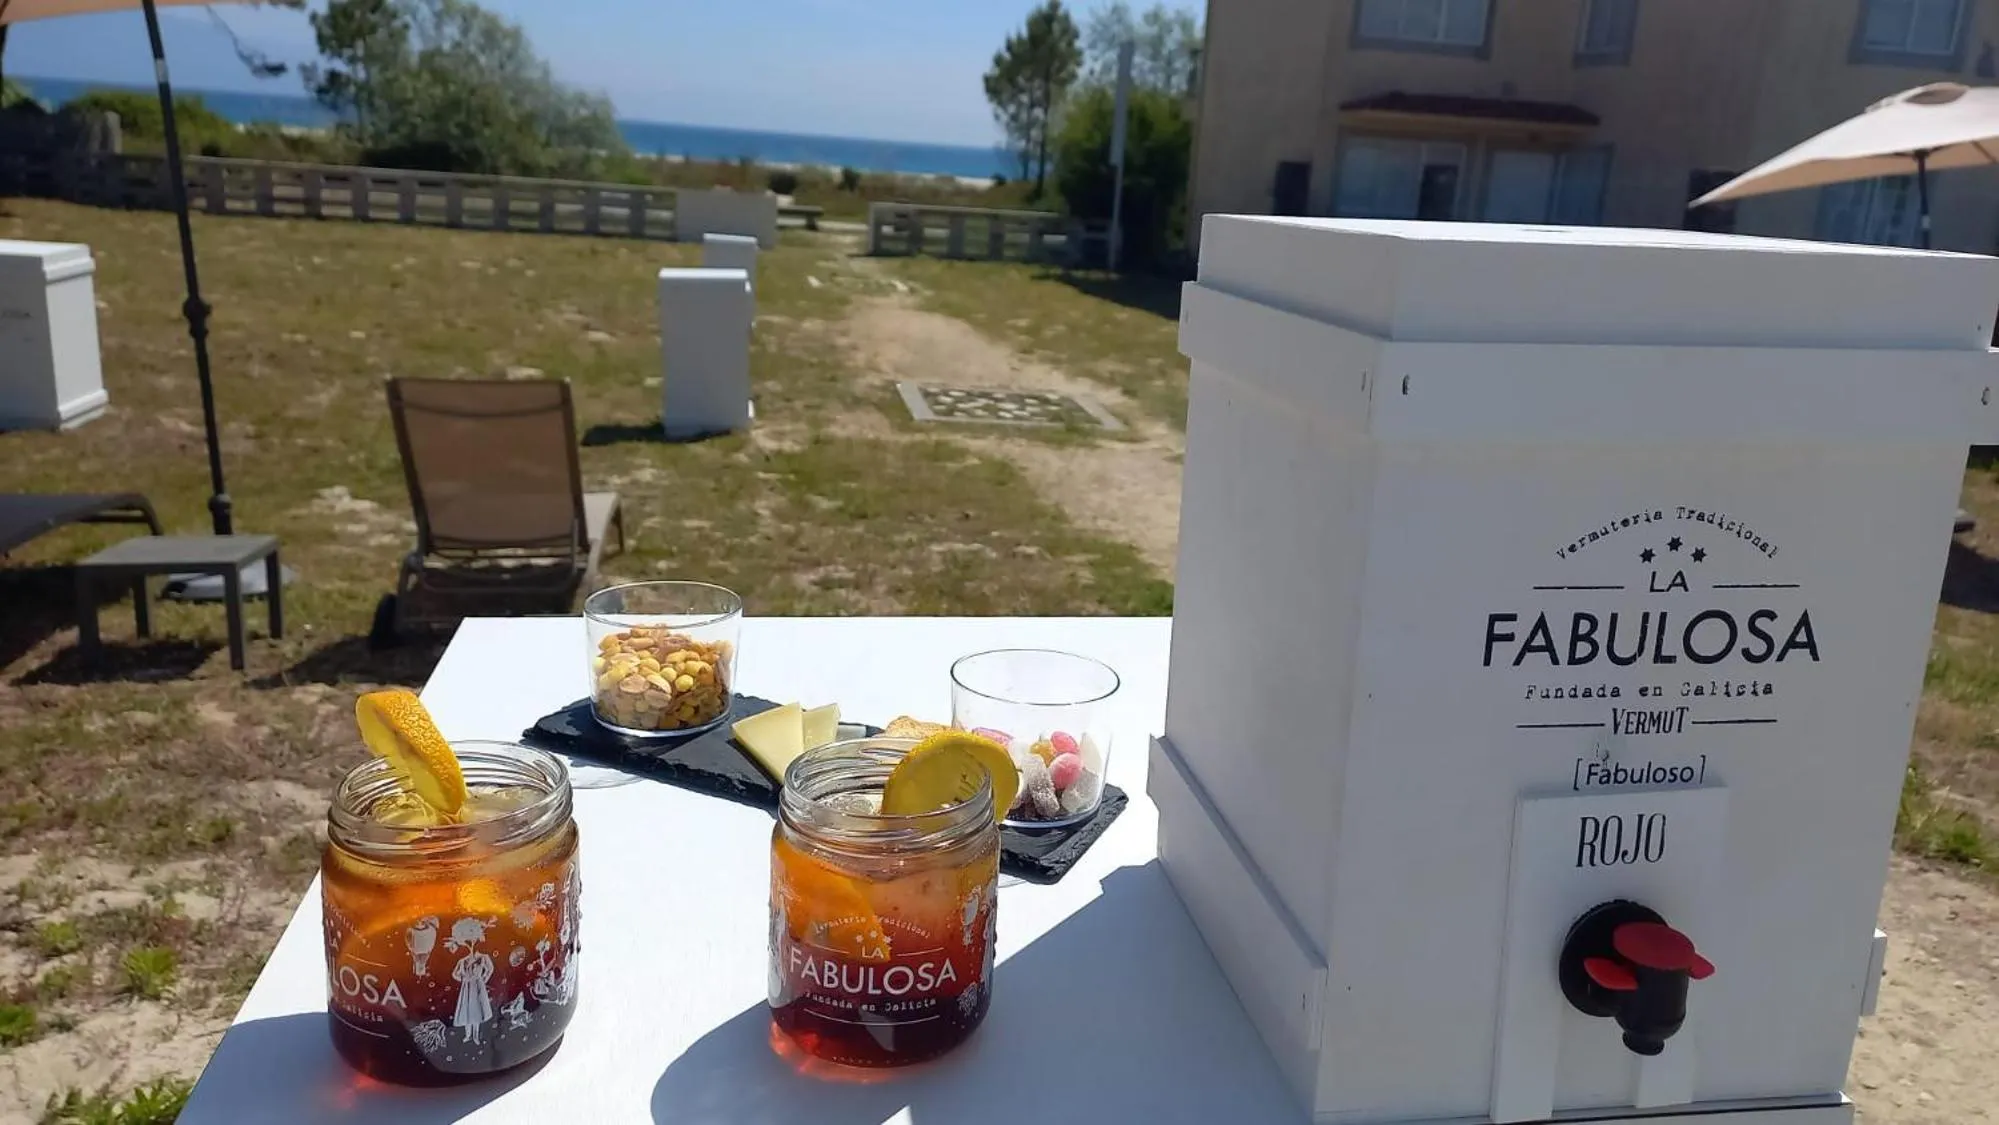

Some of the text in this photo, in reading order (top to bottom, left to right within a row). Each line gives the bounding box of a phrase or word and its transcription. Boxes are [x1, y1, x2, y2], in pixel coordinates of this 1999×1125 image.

[1556, 506, 1780, 560] Vermuteria Tradicional
[1649, 569, 1690, 593] LA
[1482, 608, 1820, 667] FABULOSA
[1525, 681, 1774, 700] Fundada en Galicia
[1611, 705, 1690, 735] VERMUT
[1576, 812, 1667, 868] ROJO
[789, 945, 957, 995] FABULOSA
[861, 947, 885, 959] LA
[330, 956, 408, 1009] LOSA
[862, 1003, 876, 1012] en
